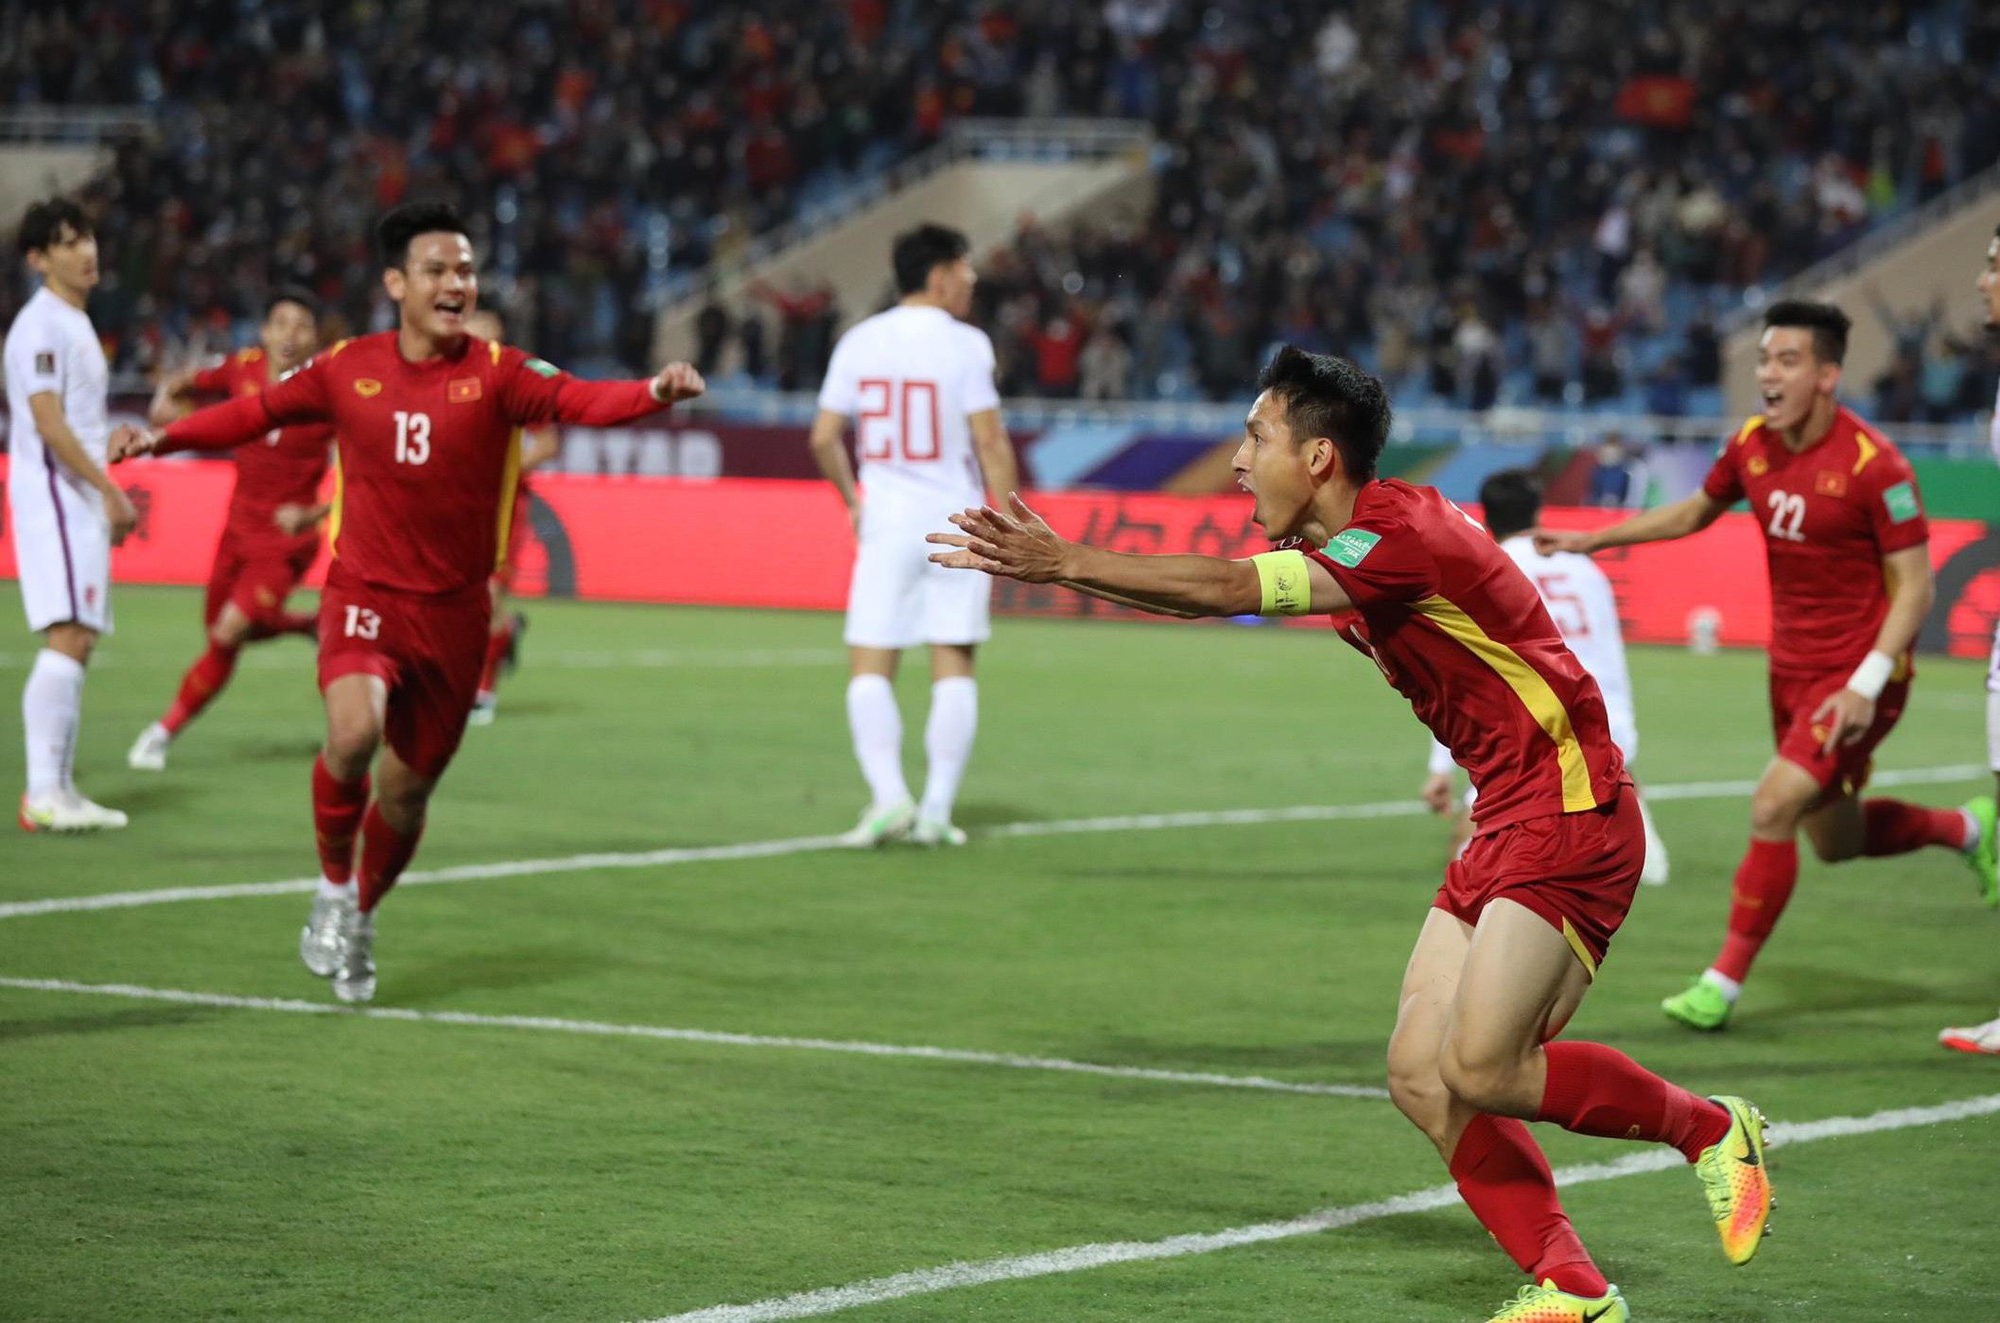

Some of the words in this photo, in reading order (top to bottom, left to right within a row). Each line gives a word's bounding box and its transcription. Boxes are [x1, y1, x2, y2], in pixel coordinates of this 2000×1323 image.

[393, 411, 431, 465] 13
[858, 378, 942, 461] 20
[1768, 489, 1806, 542] 22
[344, 605, 381, 640] 13
[1535, 574, 1588, 639] 5
